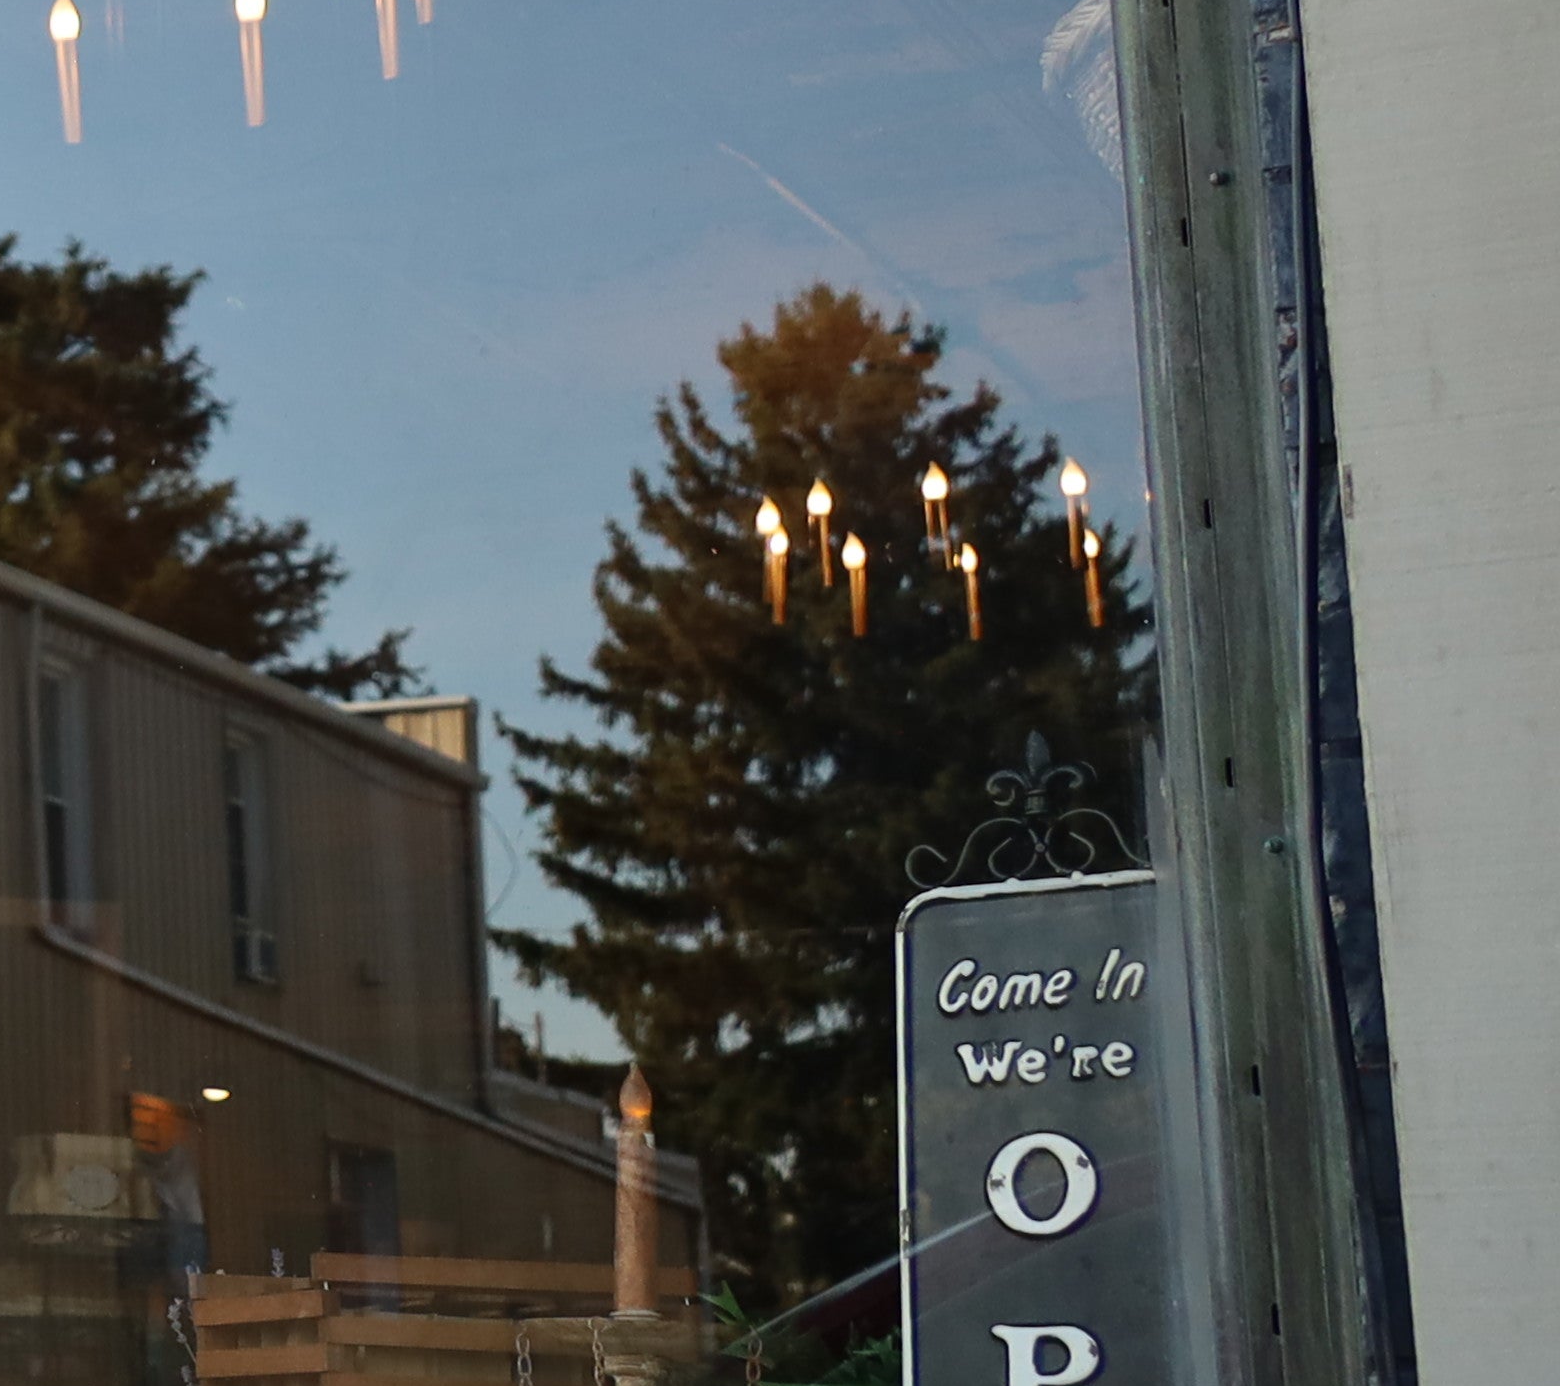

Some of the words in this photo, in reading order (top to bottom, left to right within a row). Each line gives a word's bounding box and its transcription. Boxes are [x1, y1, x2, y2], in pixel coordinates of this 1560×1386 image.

[936, 957, 1073, 1015] Come
[1093, 945, 1148, 1006] In
[956, 1036, 1135, 1088] We're
